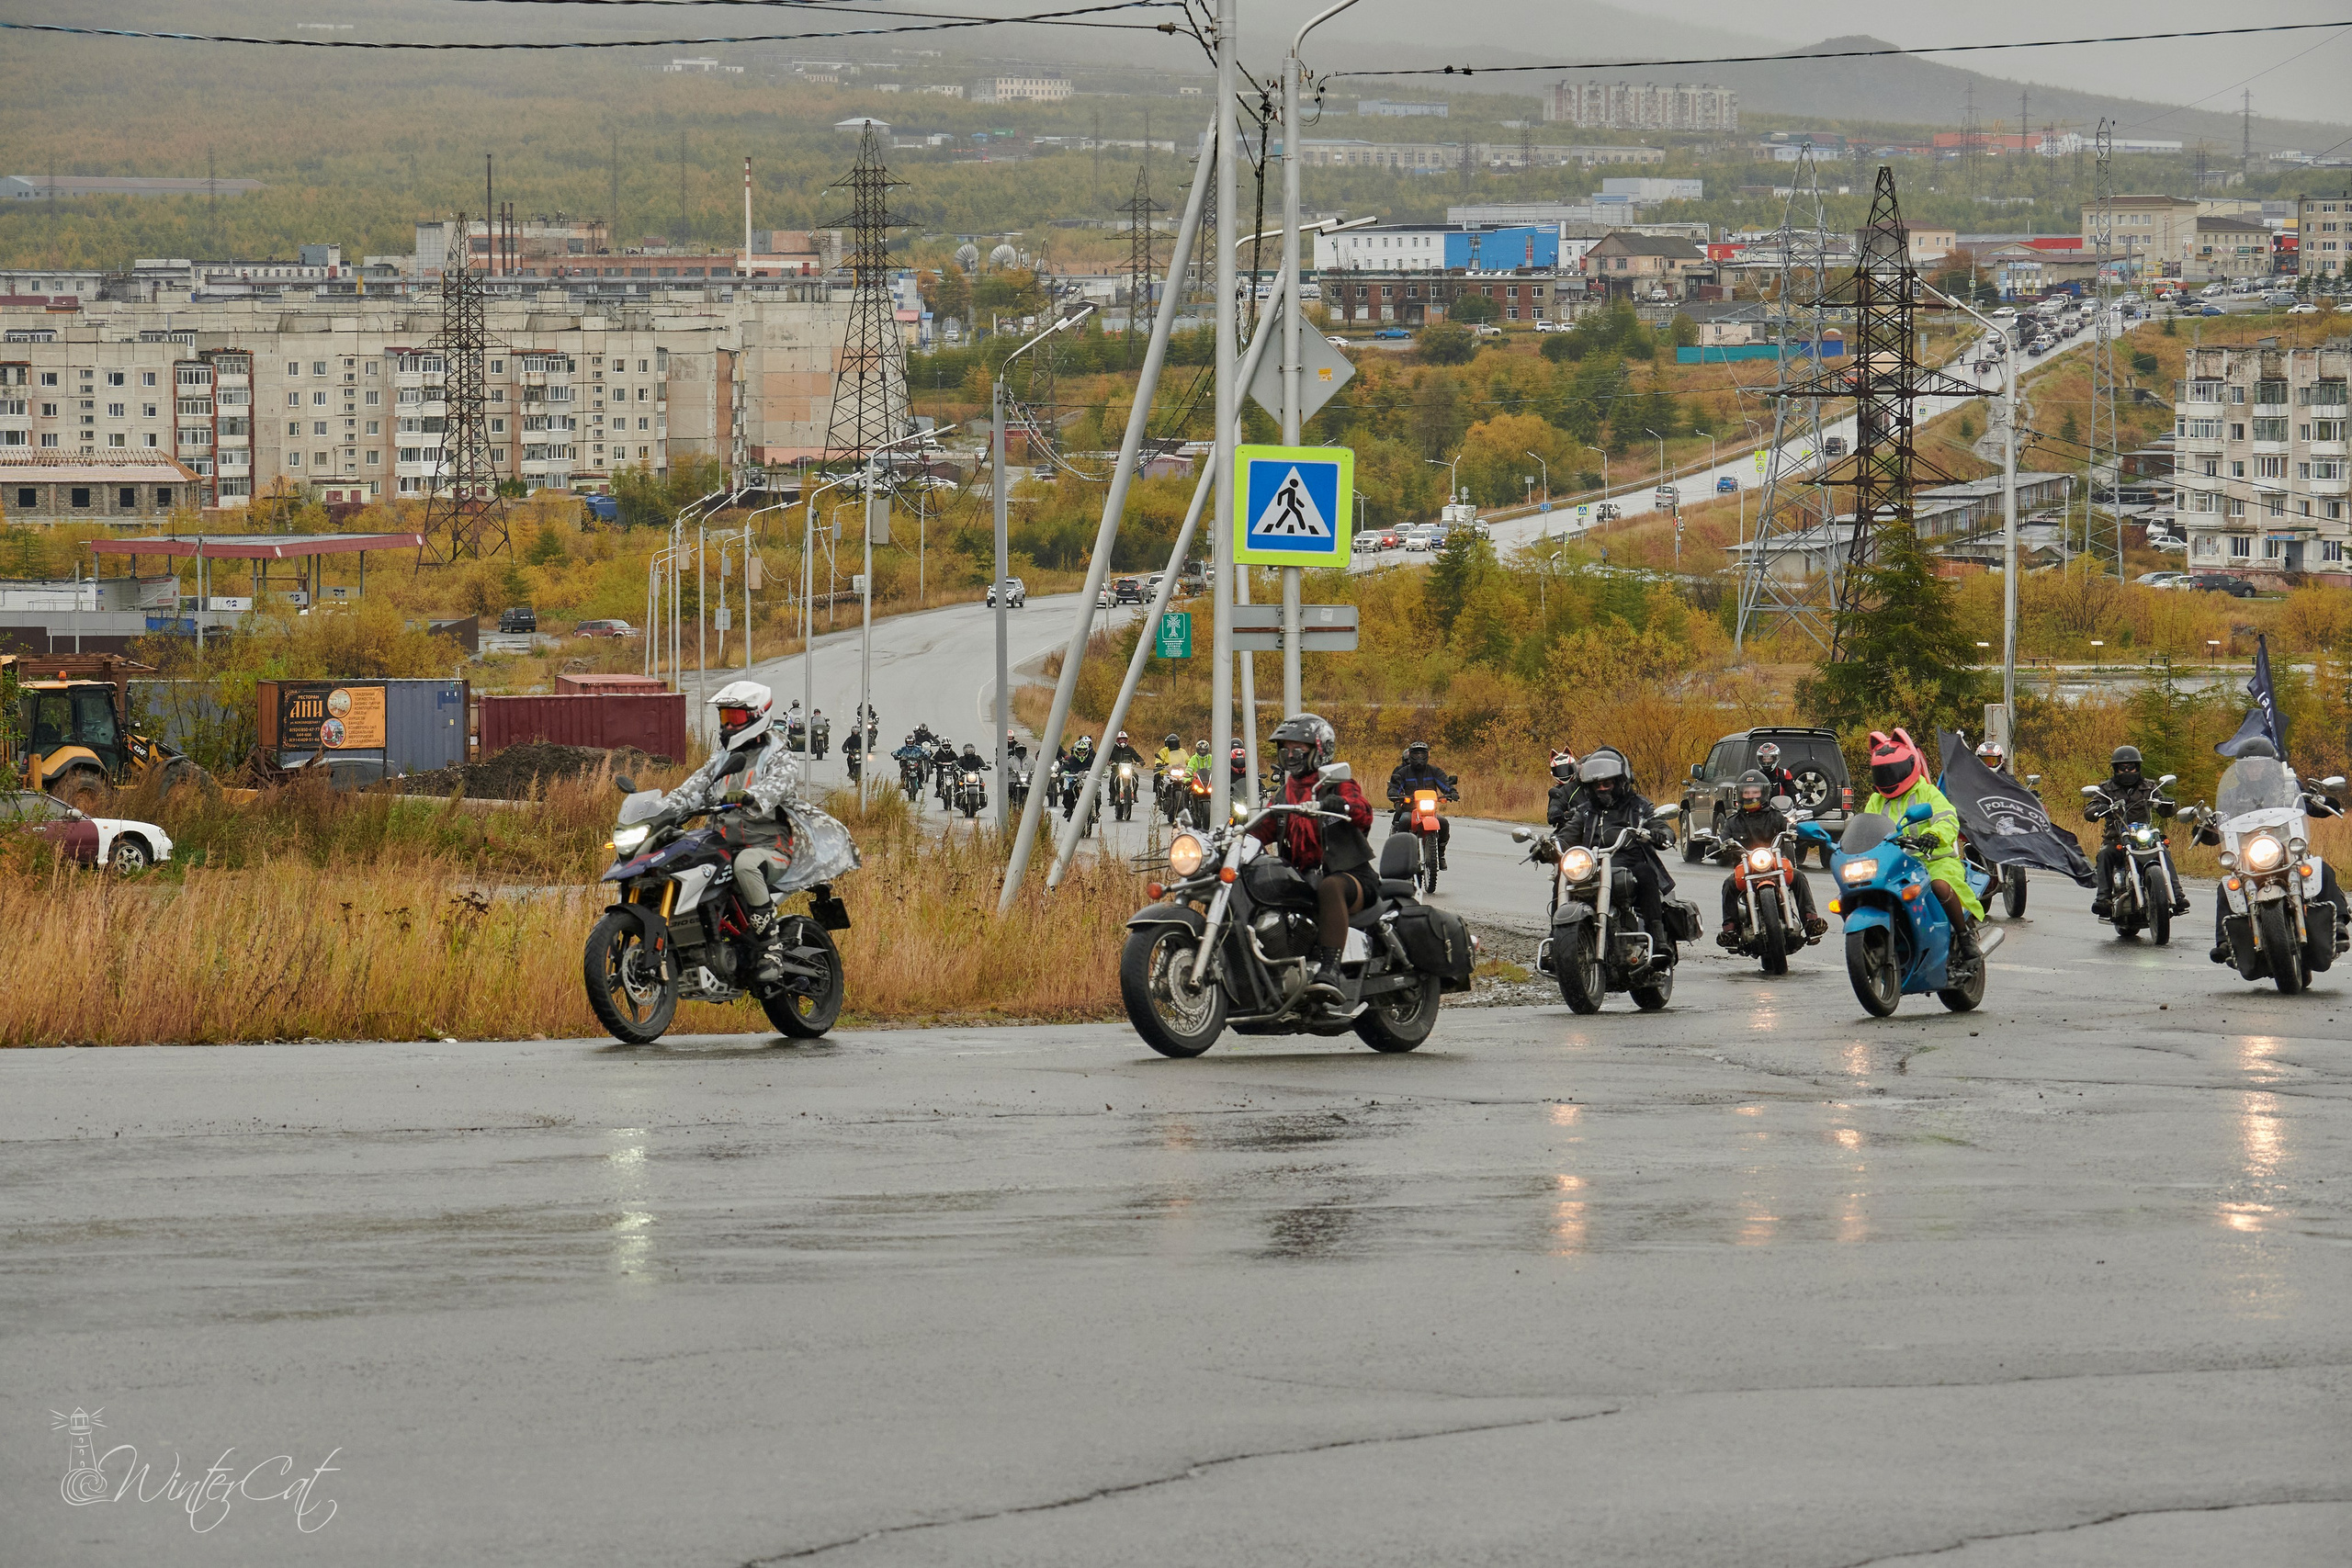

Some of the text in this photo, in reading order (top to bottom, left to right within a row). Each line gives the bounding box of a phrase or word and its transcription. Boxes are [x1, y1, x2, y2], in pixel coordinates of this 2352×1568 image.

[225, 600, 238, 608] 92
[289, 700, 322, 717] АНИ
[1984, 801, 2024, 814] POLAR
